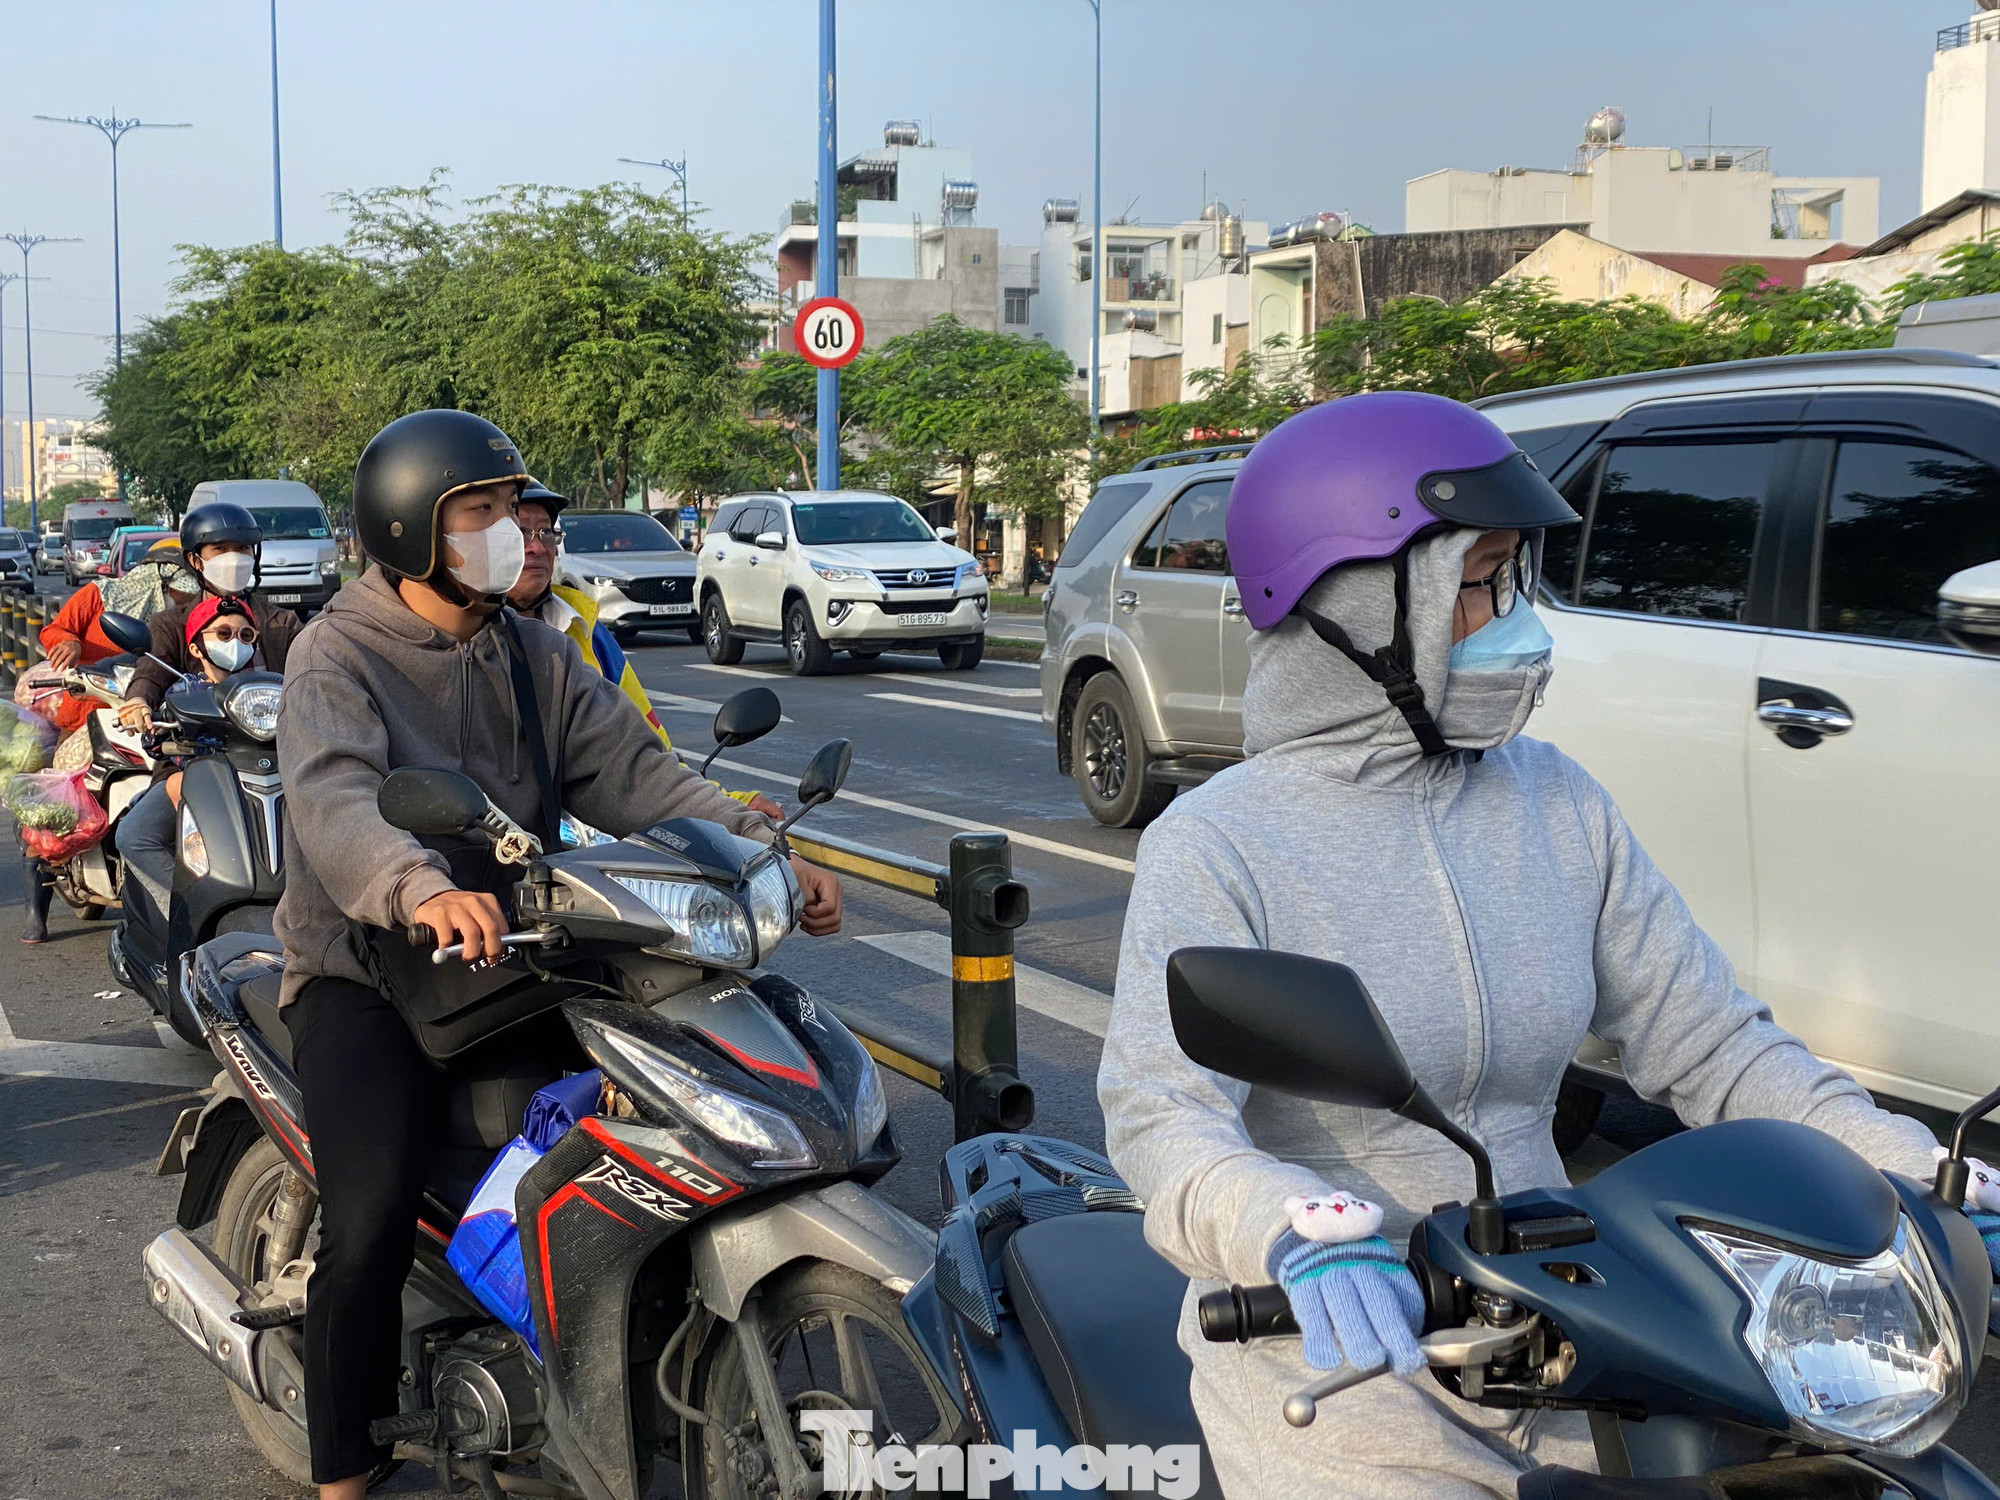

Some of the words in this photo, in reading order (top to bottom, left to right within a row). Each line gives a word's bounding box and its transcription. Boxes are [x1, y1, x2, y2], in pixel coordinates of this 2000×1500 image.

[814, 317, 843, 349] 60
[469, 945, 517, 972] TEA
[219, 1034, 278, 1099] Wave
[574, 1154, 693, 1222] RSX
[655, 1155, 723, 1195] 110
